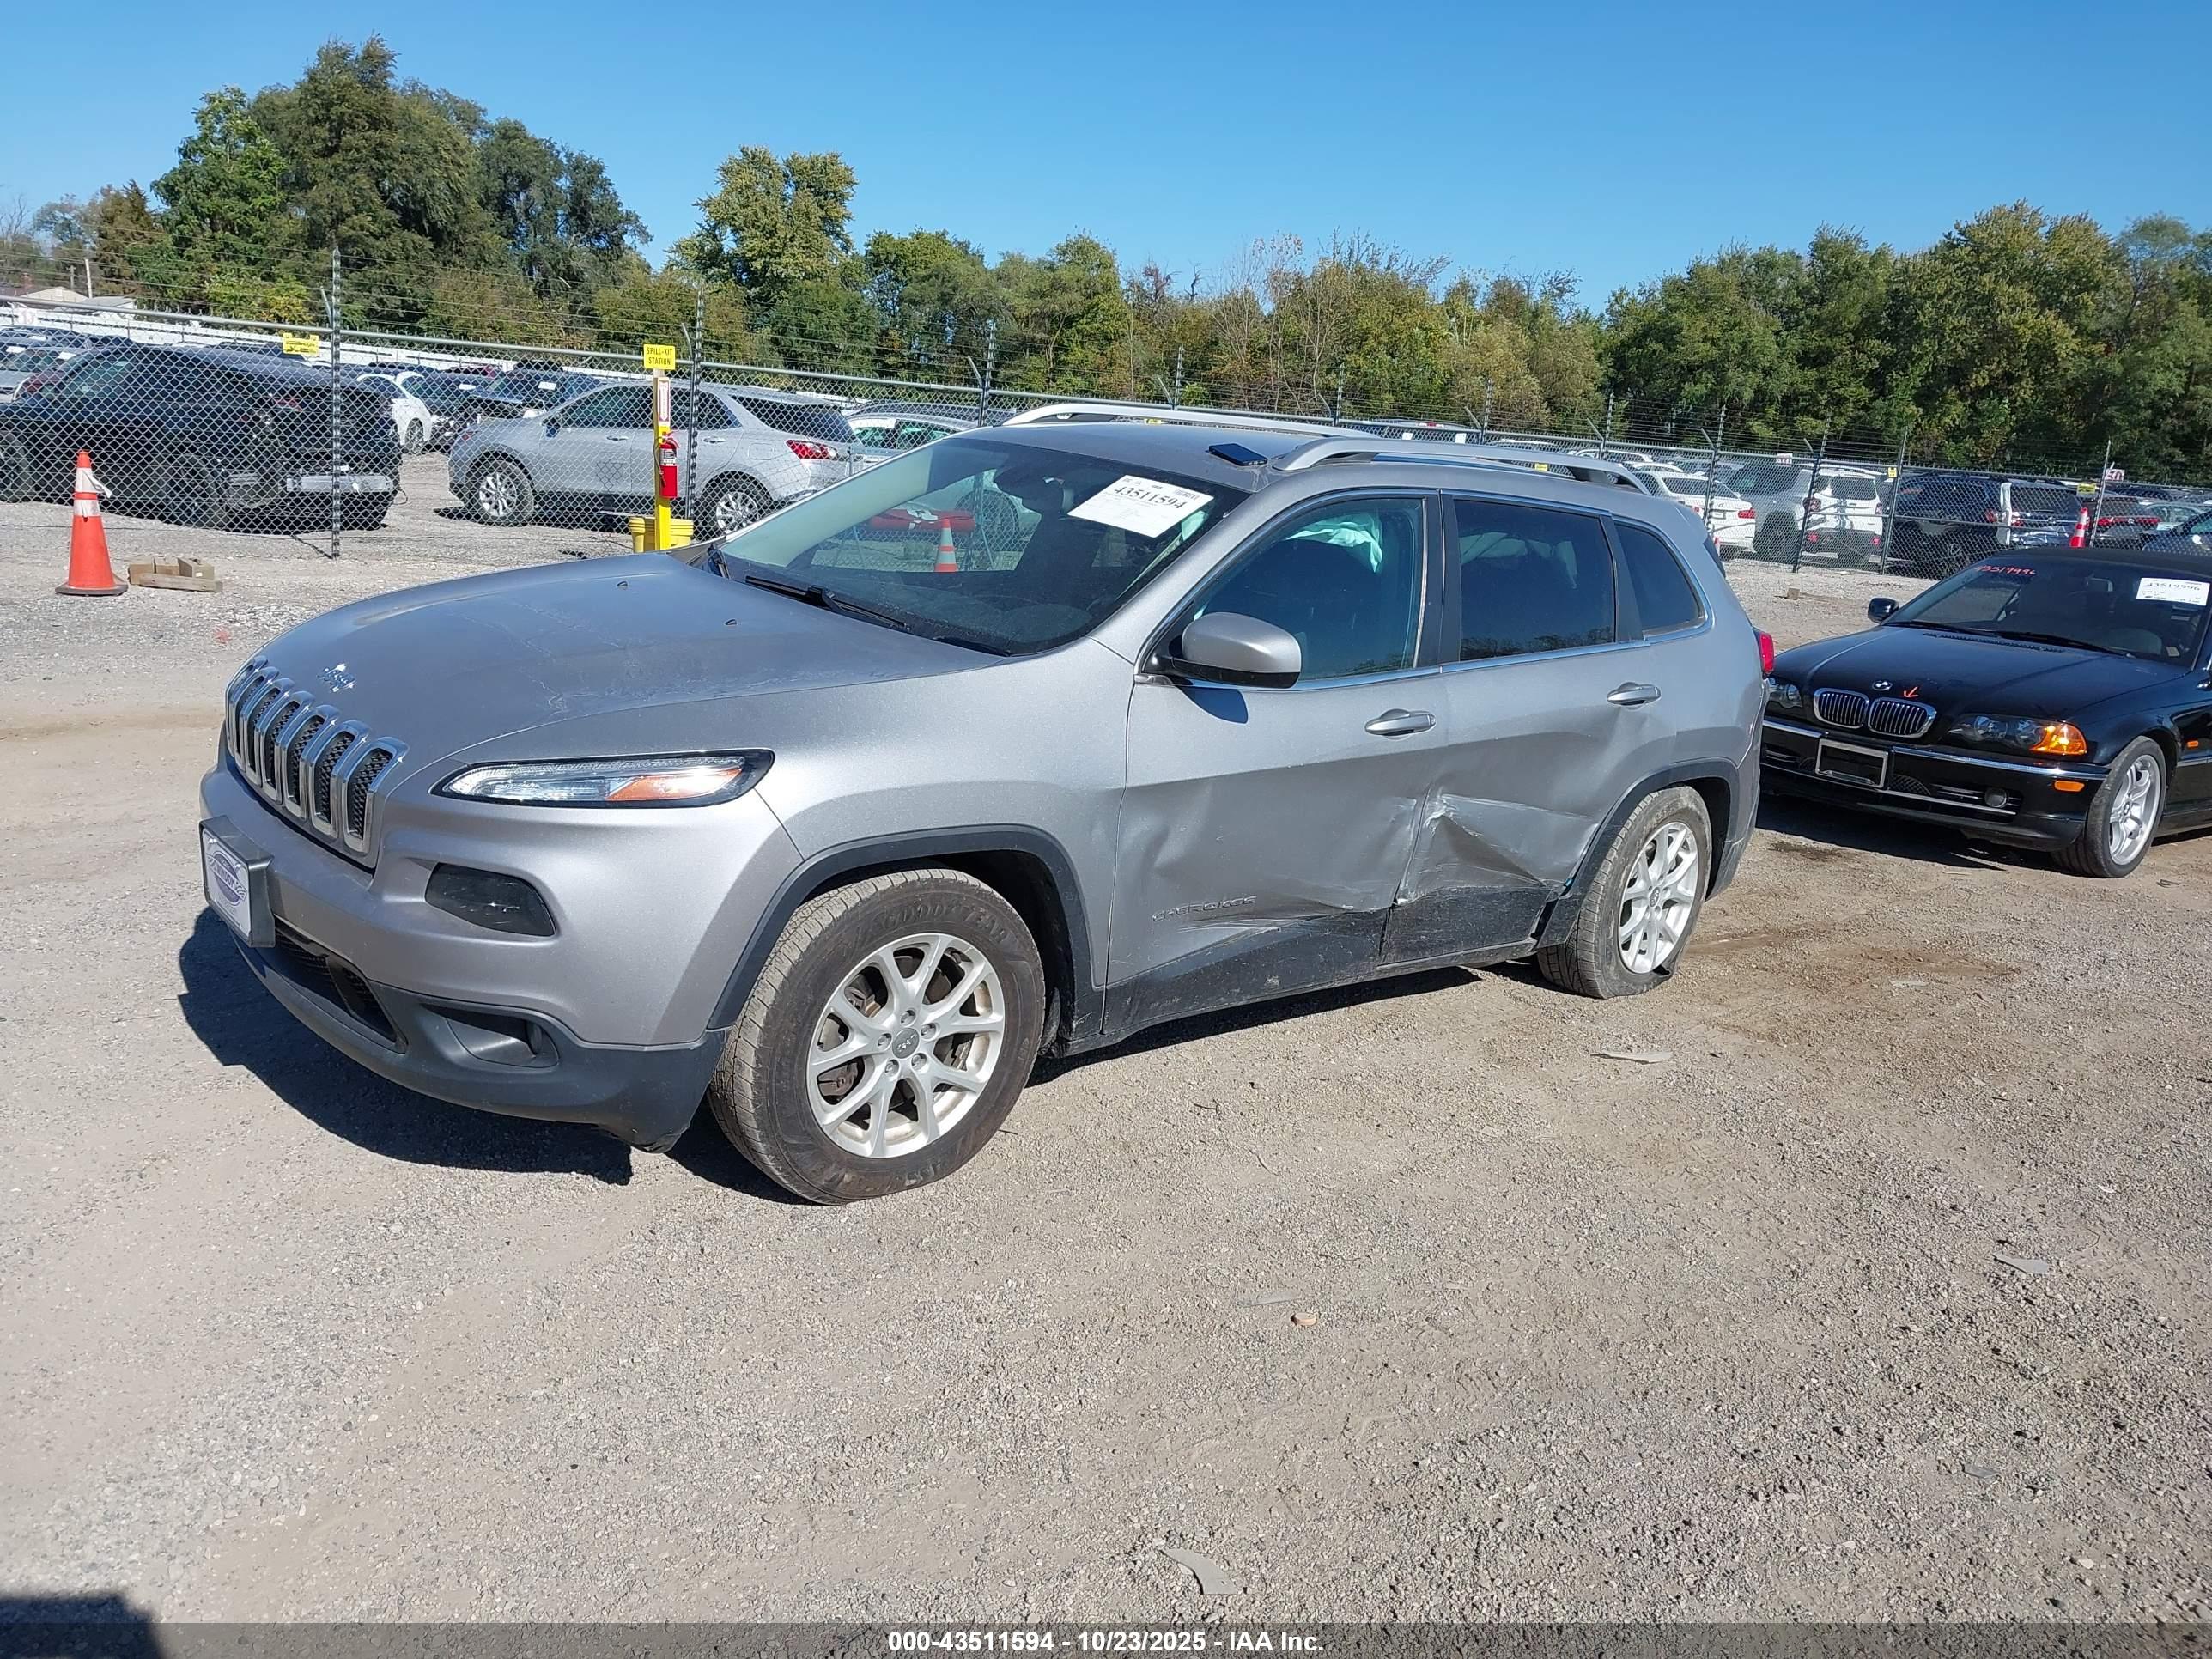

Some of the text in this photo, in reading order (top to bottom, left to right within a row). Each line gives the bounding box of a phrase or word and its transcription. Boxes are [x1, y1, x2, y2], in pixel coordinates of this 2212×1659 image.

[646, 346, 673, 356] SPILL-KIT
[648, 356, 672, 366] STATION
[1115, 485, 1188, 509] 43511594
